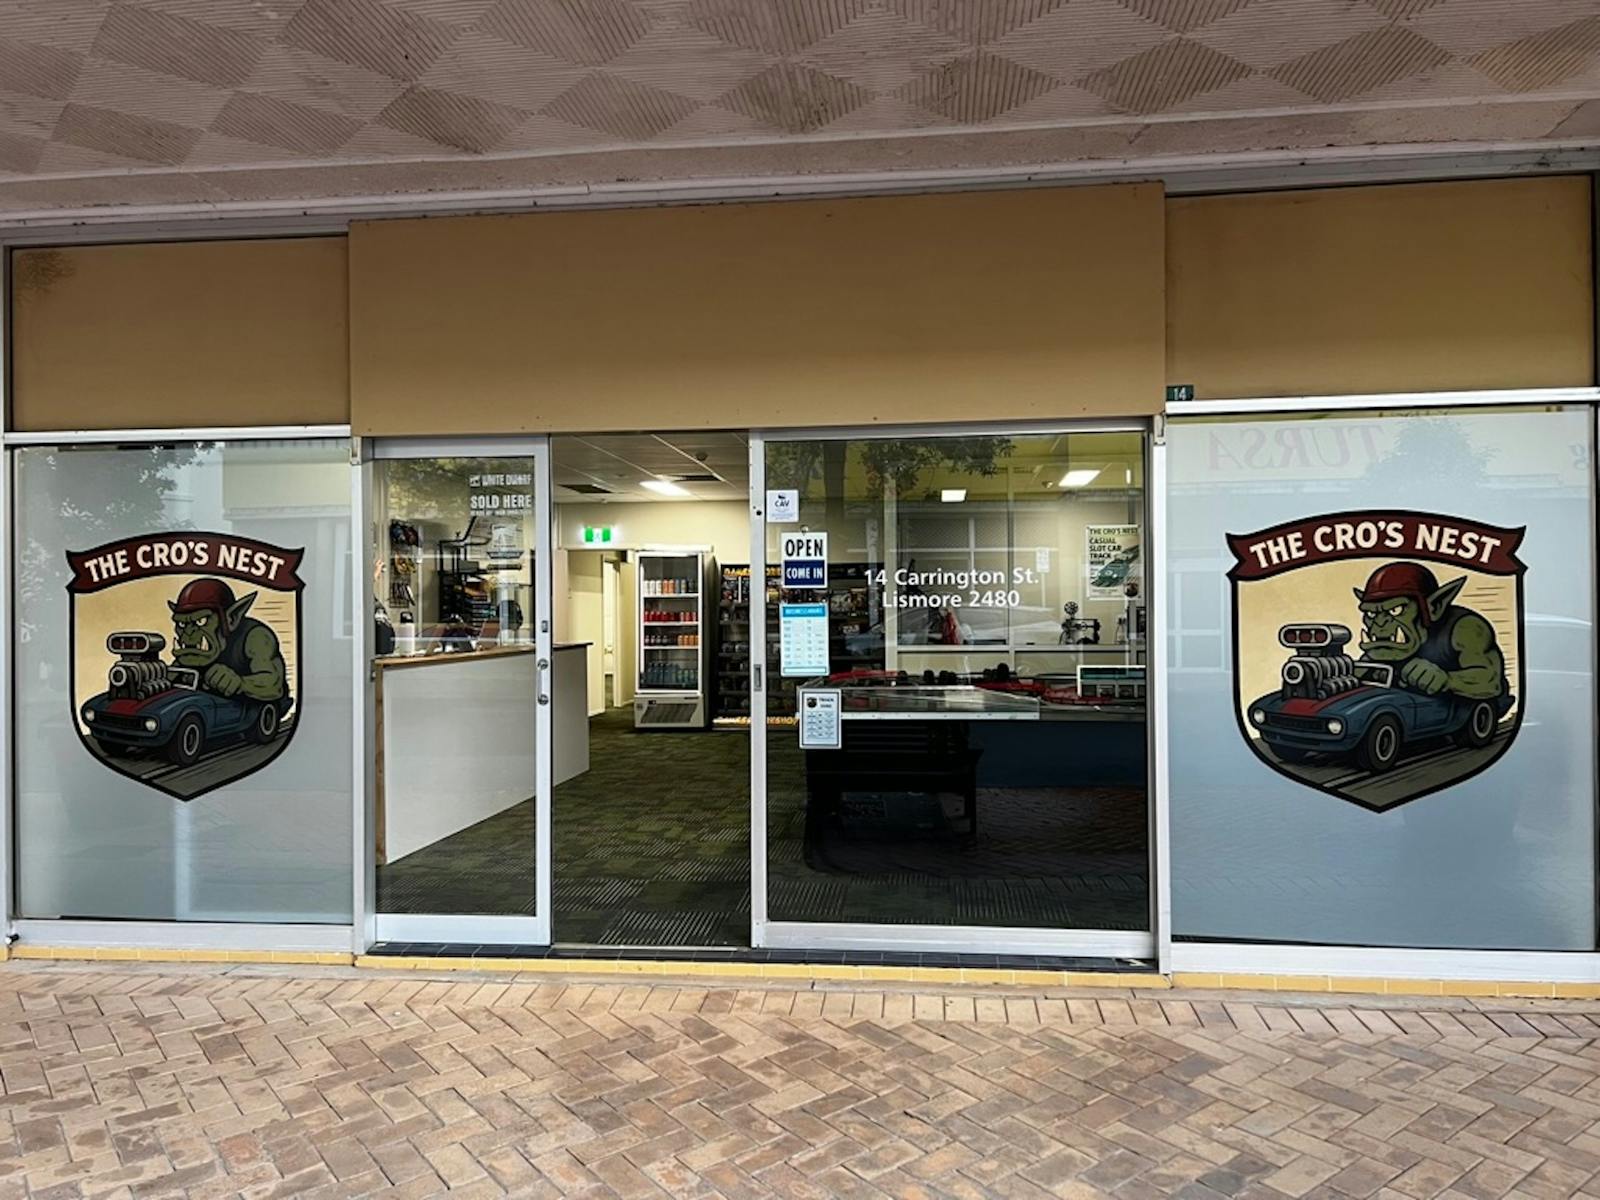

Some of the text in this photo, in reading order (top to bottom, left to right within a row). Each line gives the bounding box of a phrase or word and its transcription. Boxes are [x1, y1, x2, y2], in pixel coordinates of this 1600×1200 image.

[1173, 387, 1187, 401] 14
[470, 494, 532, 509] SOLD HERE
[785, 539, 823, 557] OPEN
[1249, 520, 1501, 569] THE CRO'S NEST
[84, 541, 285, 583] THE CRO'S NEST
[786, 567, 811, 579] COME
[813, 567, 823, 579] IN
[864, 567, 1039, 589] 14 Carrington St.
[882, 591, 962, 608] Lismore
[969, 590, 1020, 608] 2480
